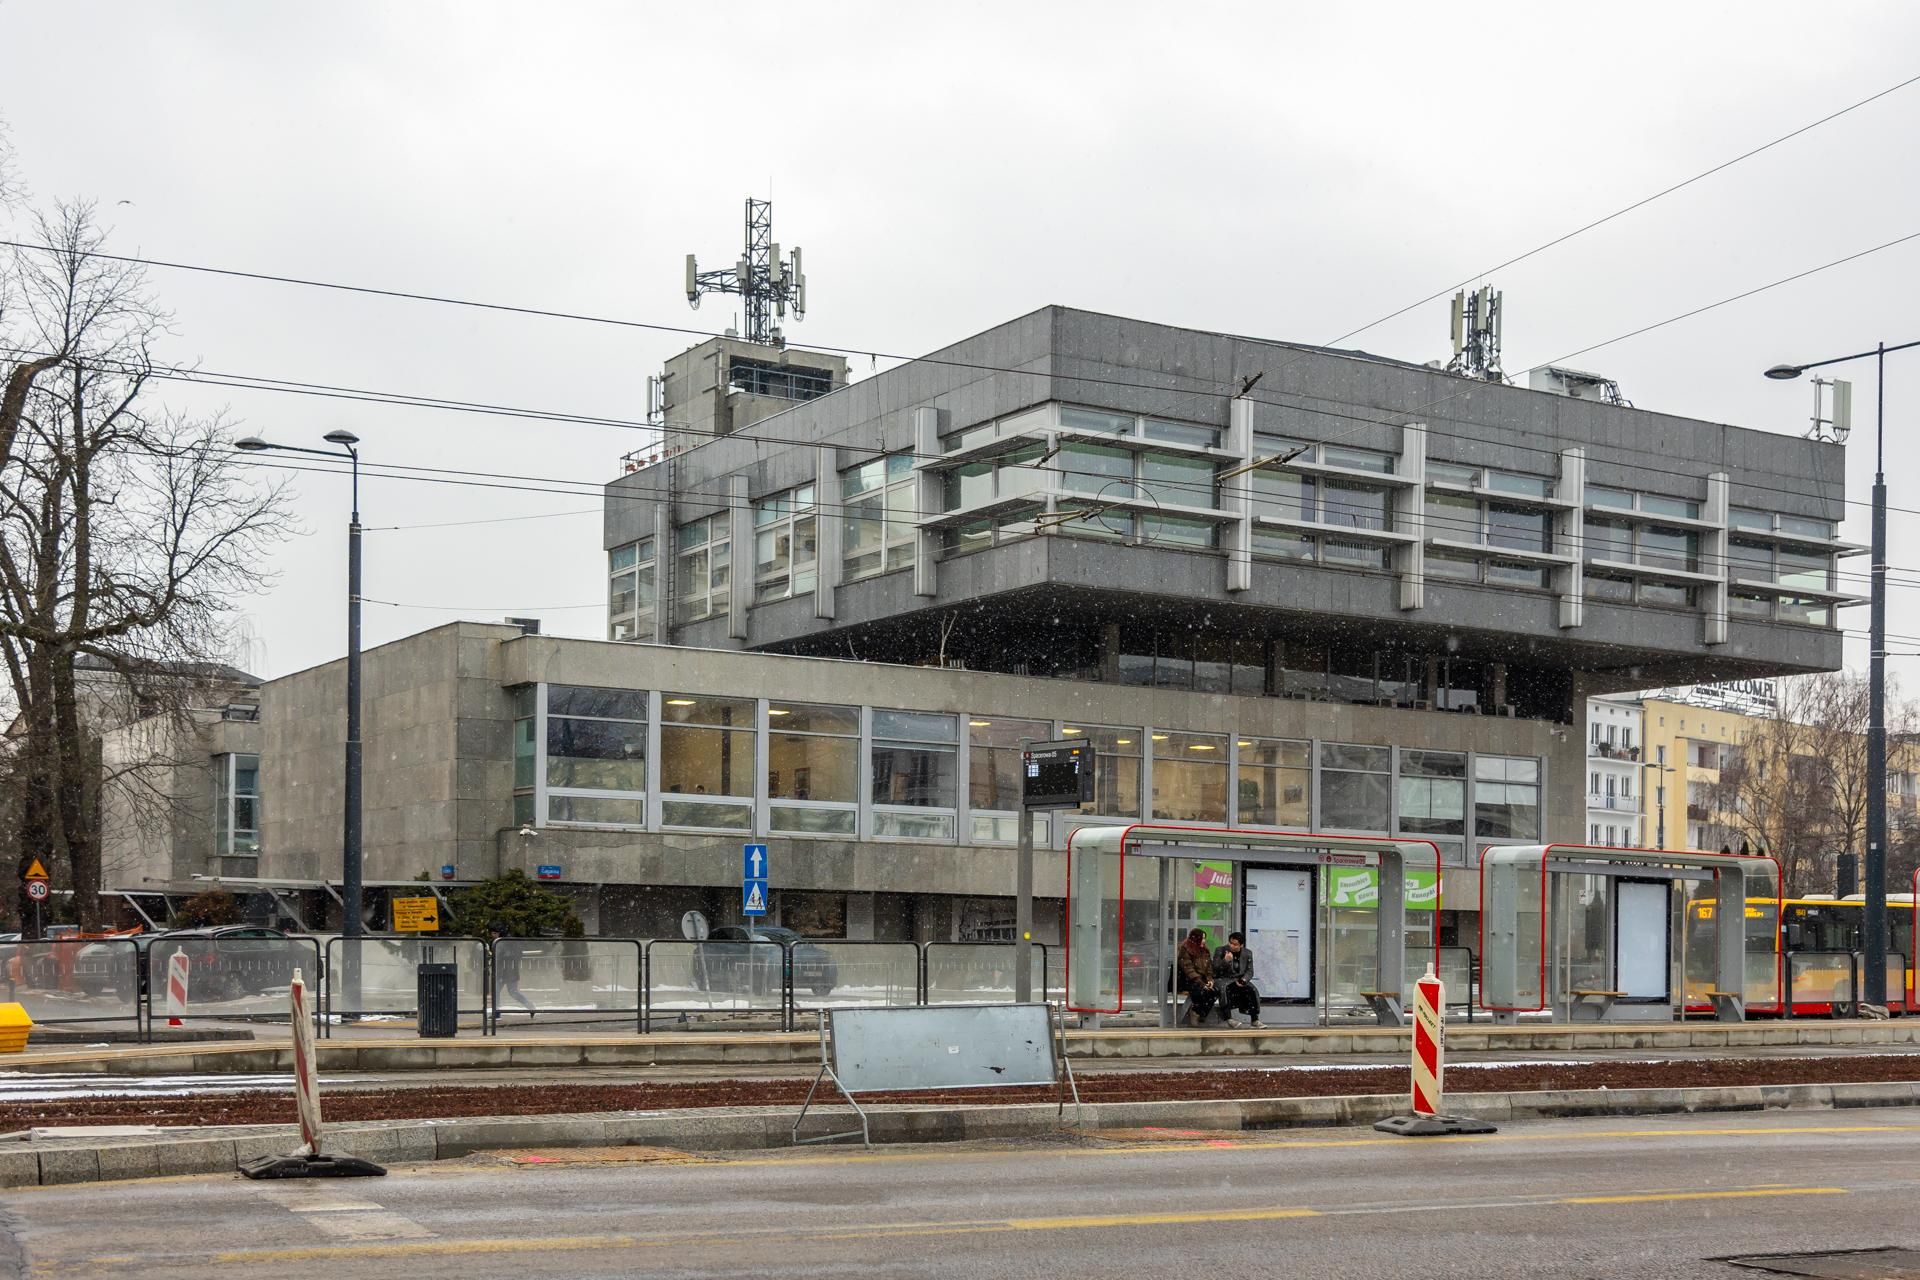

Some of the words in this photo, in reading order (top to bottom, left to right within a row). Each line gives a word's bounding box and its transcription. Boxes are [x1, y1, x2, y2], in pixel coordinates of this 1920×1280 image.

[1333, 856, 1359, 865] Spacerowa
[31, 885, 45, 895] 30
[1697, 907, 1713, 919] 167
